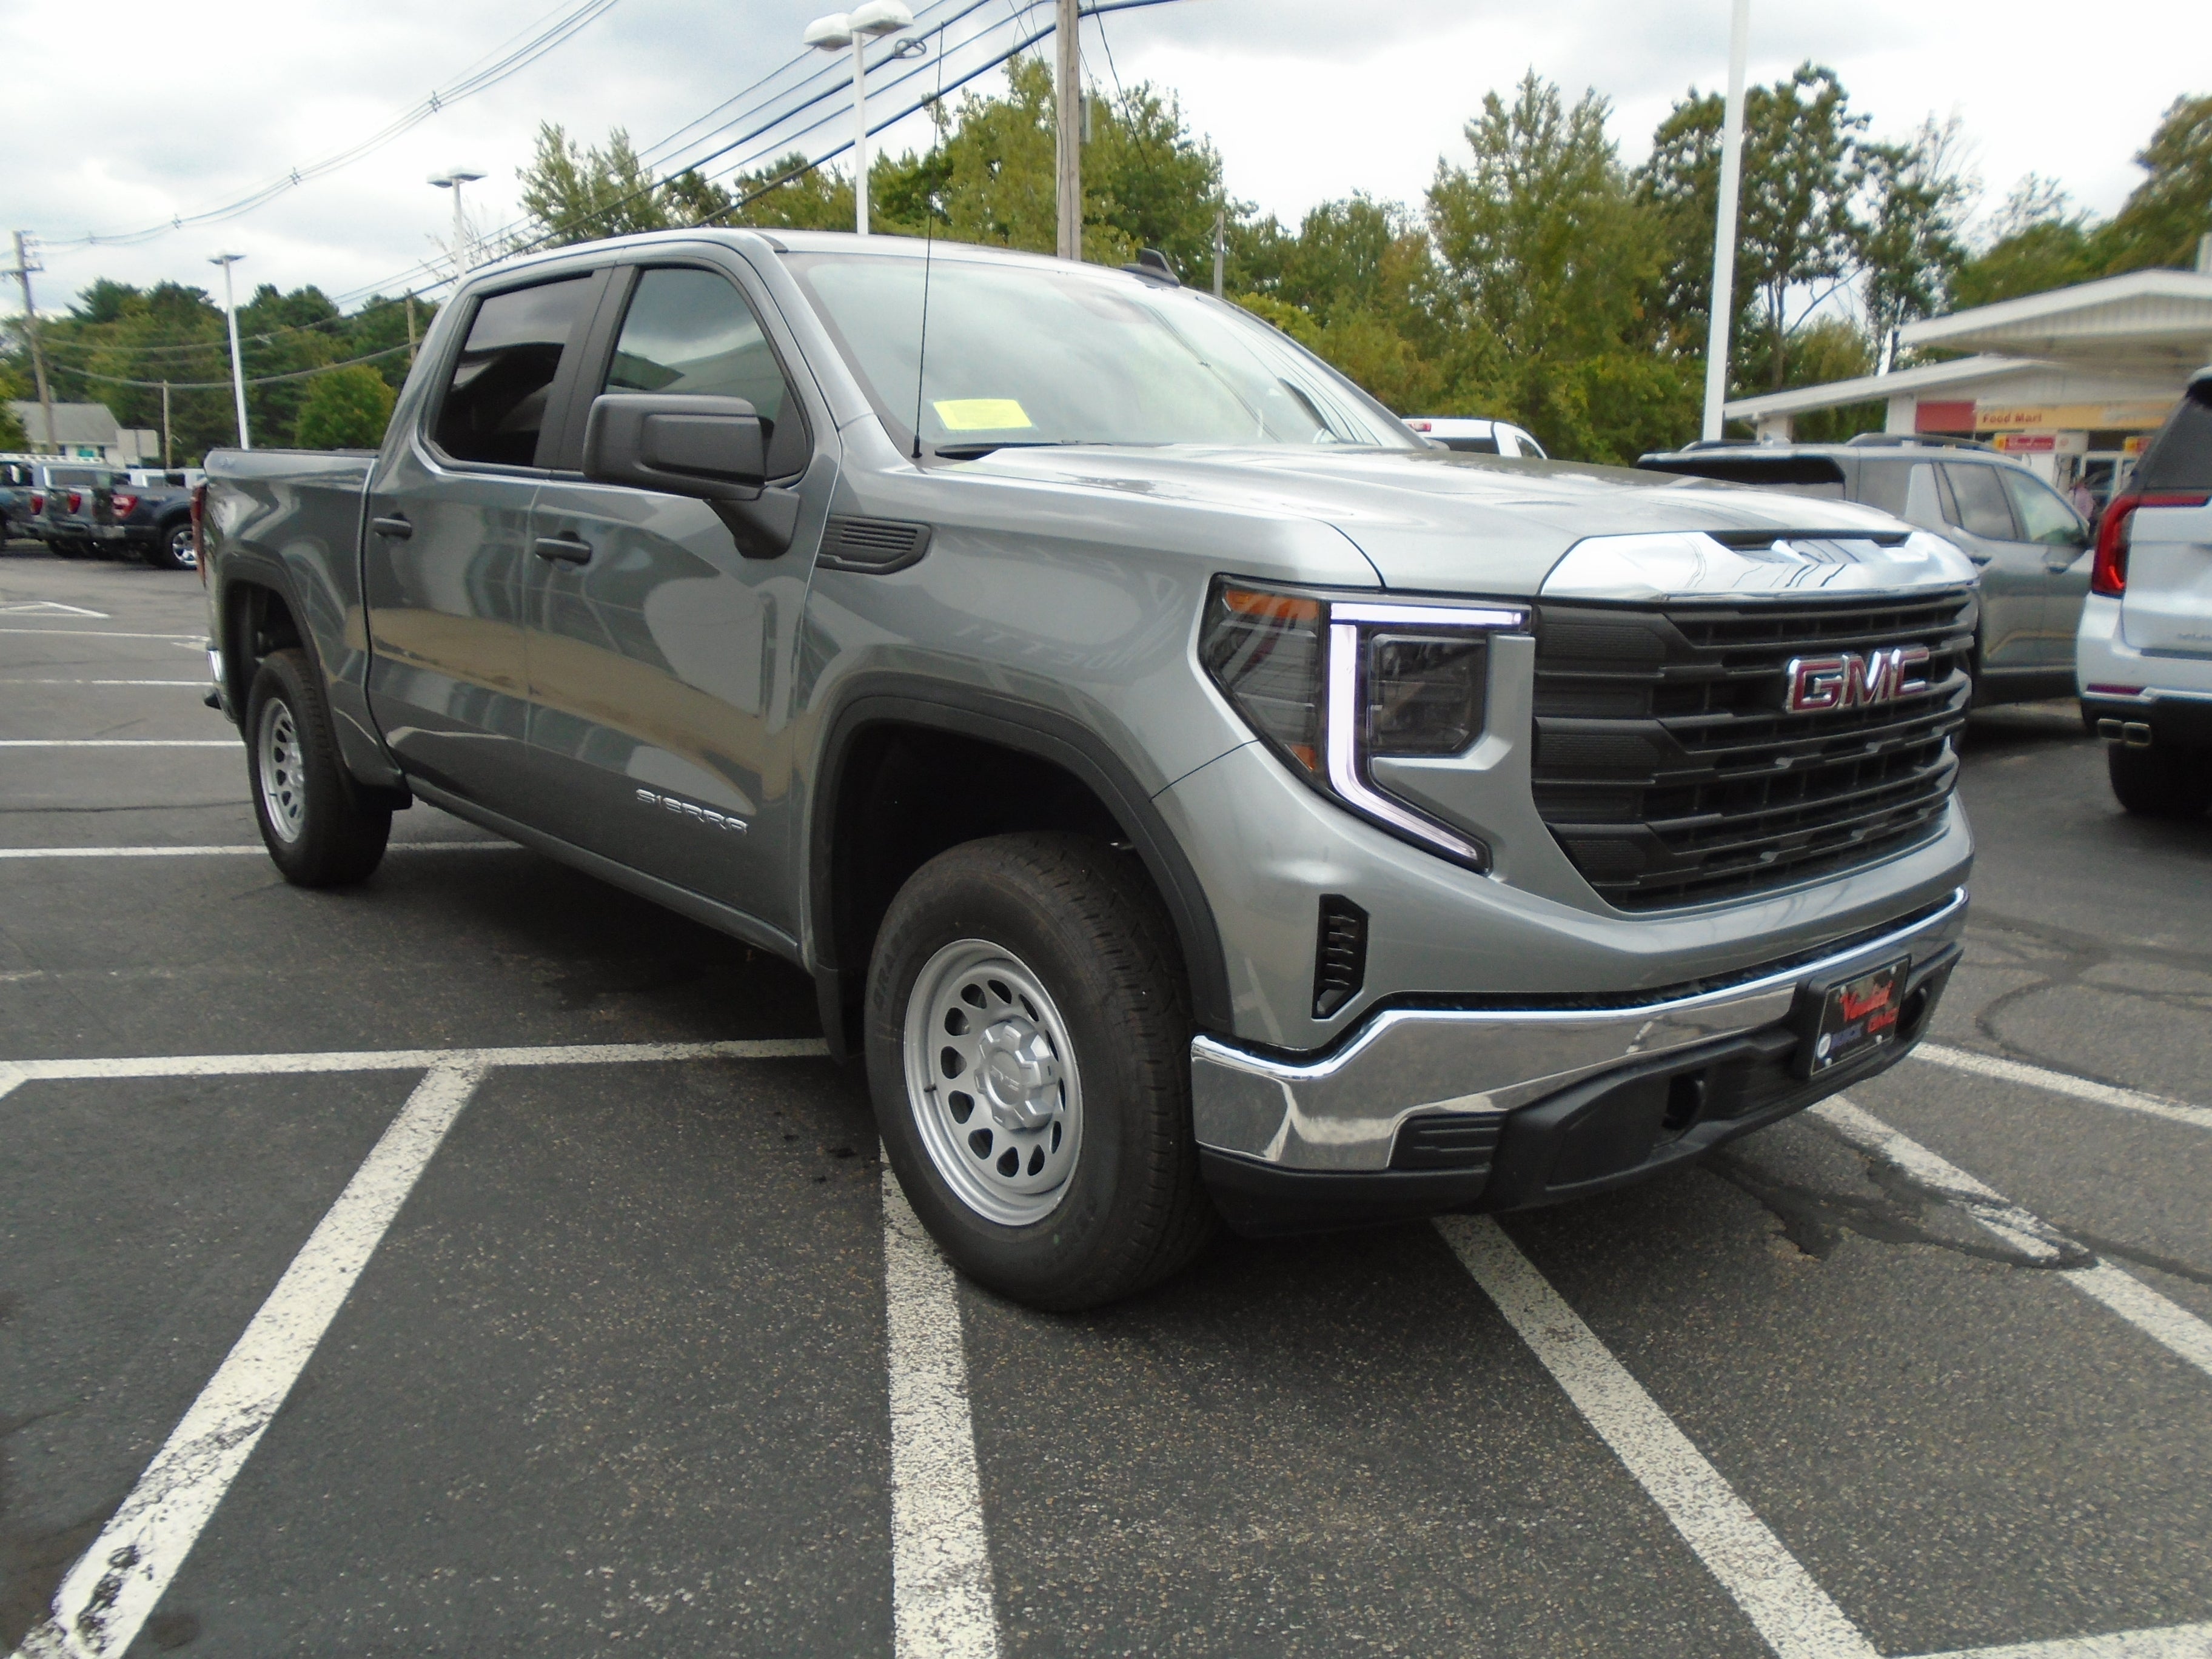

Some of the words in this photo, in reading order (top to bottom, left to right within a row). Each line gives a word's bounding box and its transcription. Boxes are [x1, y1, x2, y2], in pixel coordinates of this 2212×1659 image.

[1983, 413, 2011, 423] Food
[2015, 413, 2042, 423] Mart
[1786, 647, 1929, 713] GMC
[636, 789, 749, 834] SIERRA
